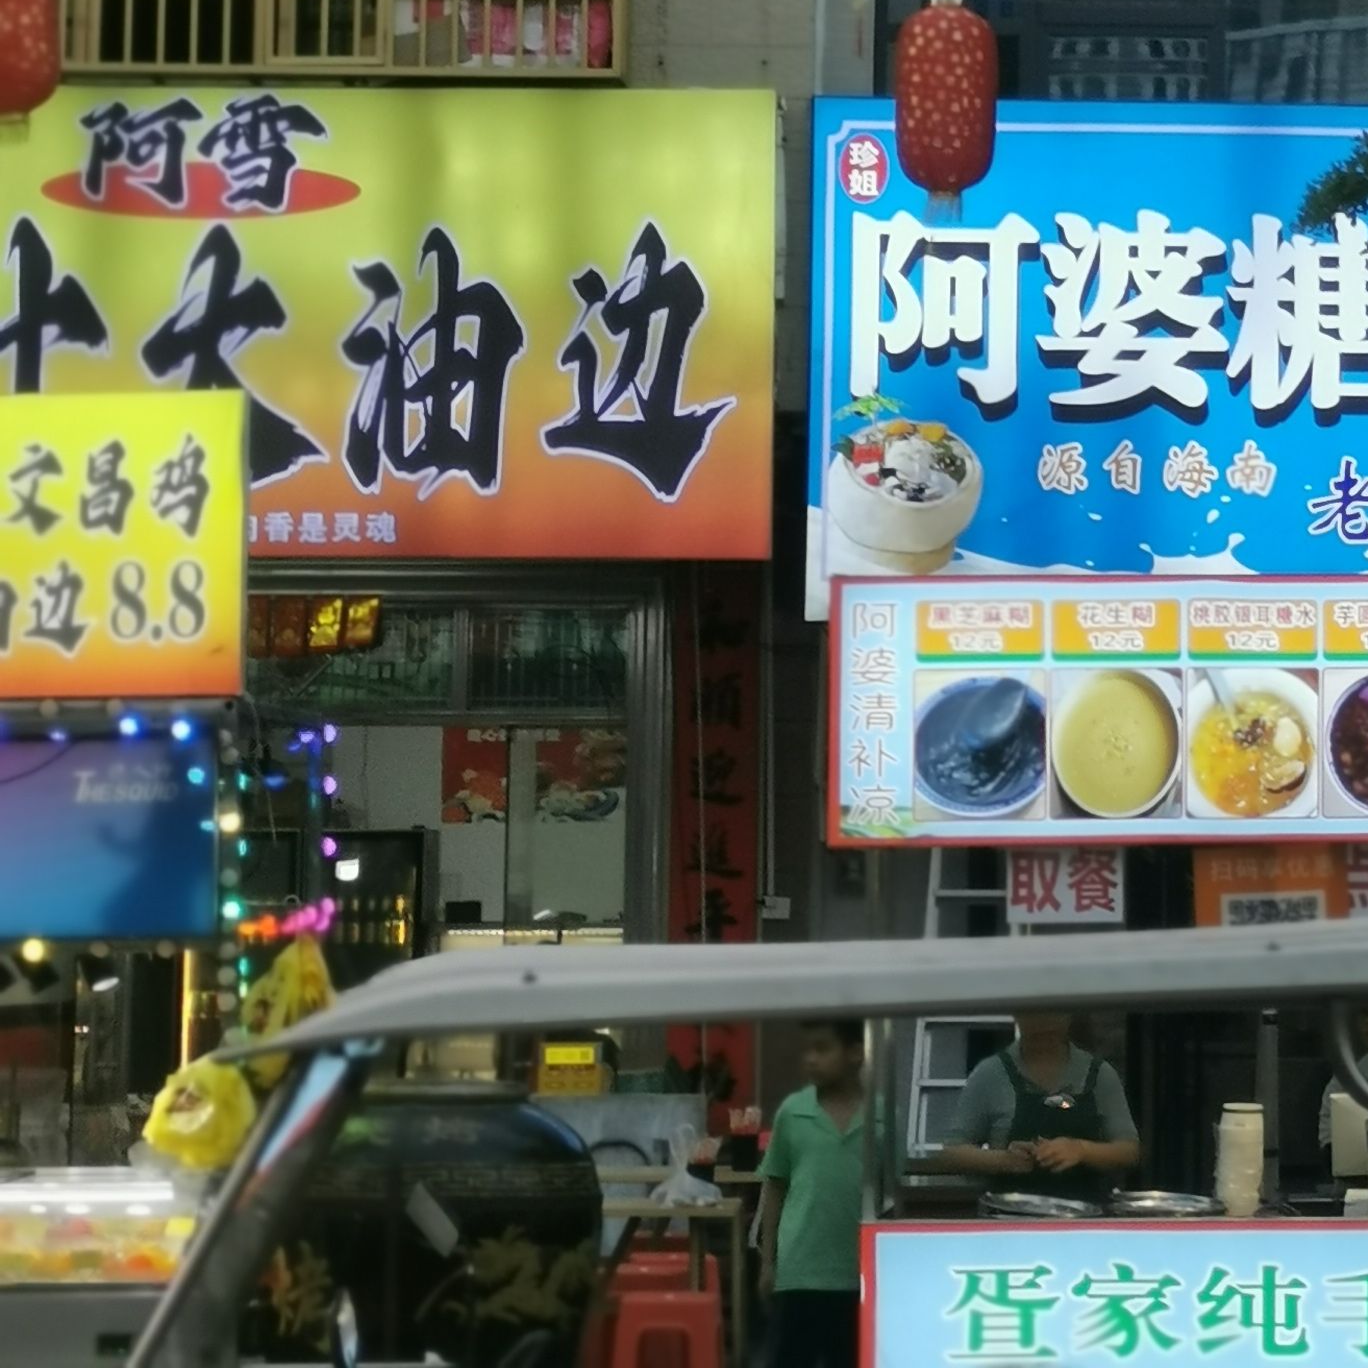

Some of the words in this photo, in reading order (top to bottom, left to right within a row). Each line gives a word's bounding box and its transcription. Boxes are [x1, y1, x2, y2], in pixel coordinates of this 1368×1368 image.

[80, 93, 328, 212] 阿雪
[847, 140, 879, 196] 珍姐
[5, 433, 210, 538] 文昌鸡
[1038, 439, 1277, 498] 源自海南
[111, 561, 206, 641] 8.8
[930, 603, 1032, 628] 黑芝麻糊
[1079, 603, 1156, 627] 花生糊
[950, 632, 1001, 651] 12元
[1090, 632, 1142, 650] 12元
[1226, 632, 1279, 650] 12元
[849, 603, 899, 824] 阿婆清补凉
[1010, 847, 1119, 914] 取餐
